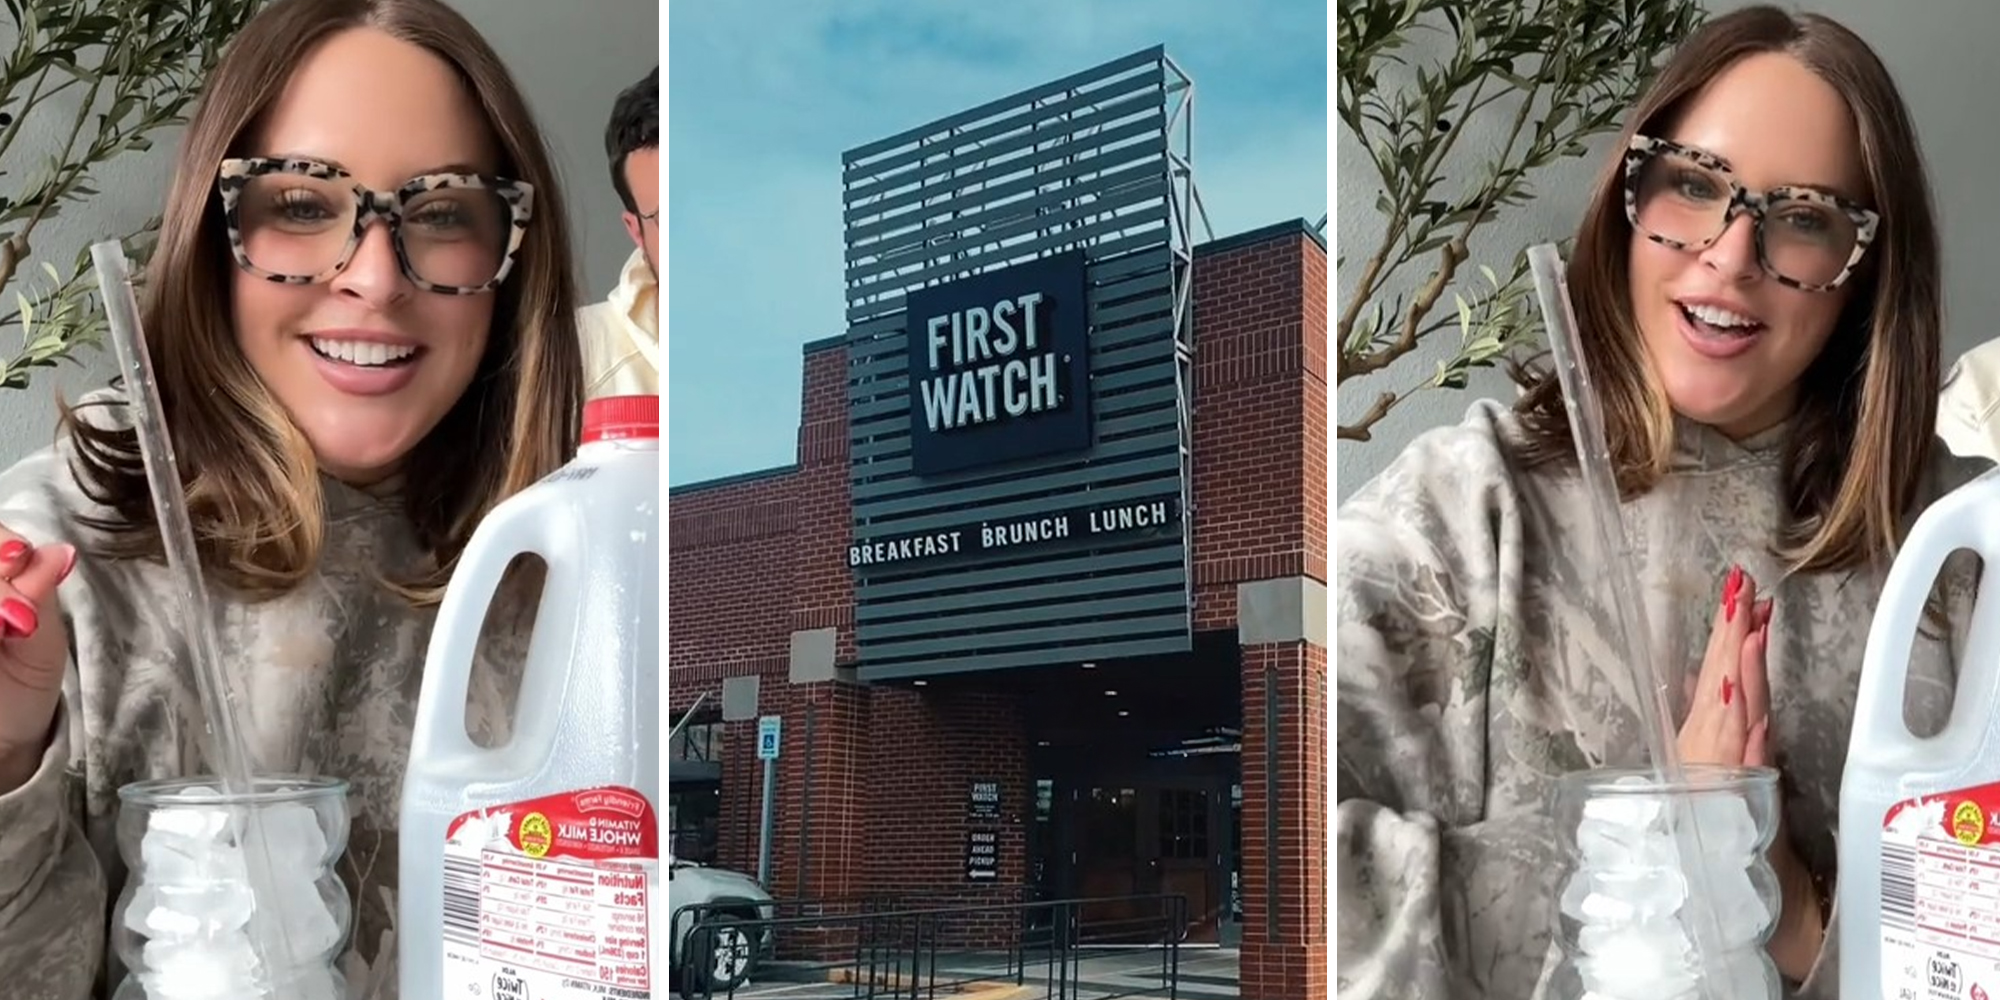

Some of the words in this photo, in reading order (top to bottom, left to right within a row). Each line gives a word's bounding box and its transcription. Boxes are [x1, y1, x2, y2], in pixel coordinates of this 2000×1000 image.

[927, 292, 1043, 370] FIRST
[920, 353, 1058, 432] WATCH
[849, 532, 962, 566] BREAKFAST
[982, 516, 1069, 548] BRUNCH
[1090, 502, 1166, 533] LUNCH
[974, 783, 997, 792] FIRST
[971, 793, 998, 802] WATCH
[972, 833, 995, 842] ORDER
[972, 845, 995, 854] AHEAD
[969, 857, 996, 866] PICKUP
